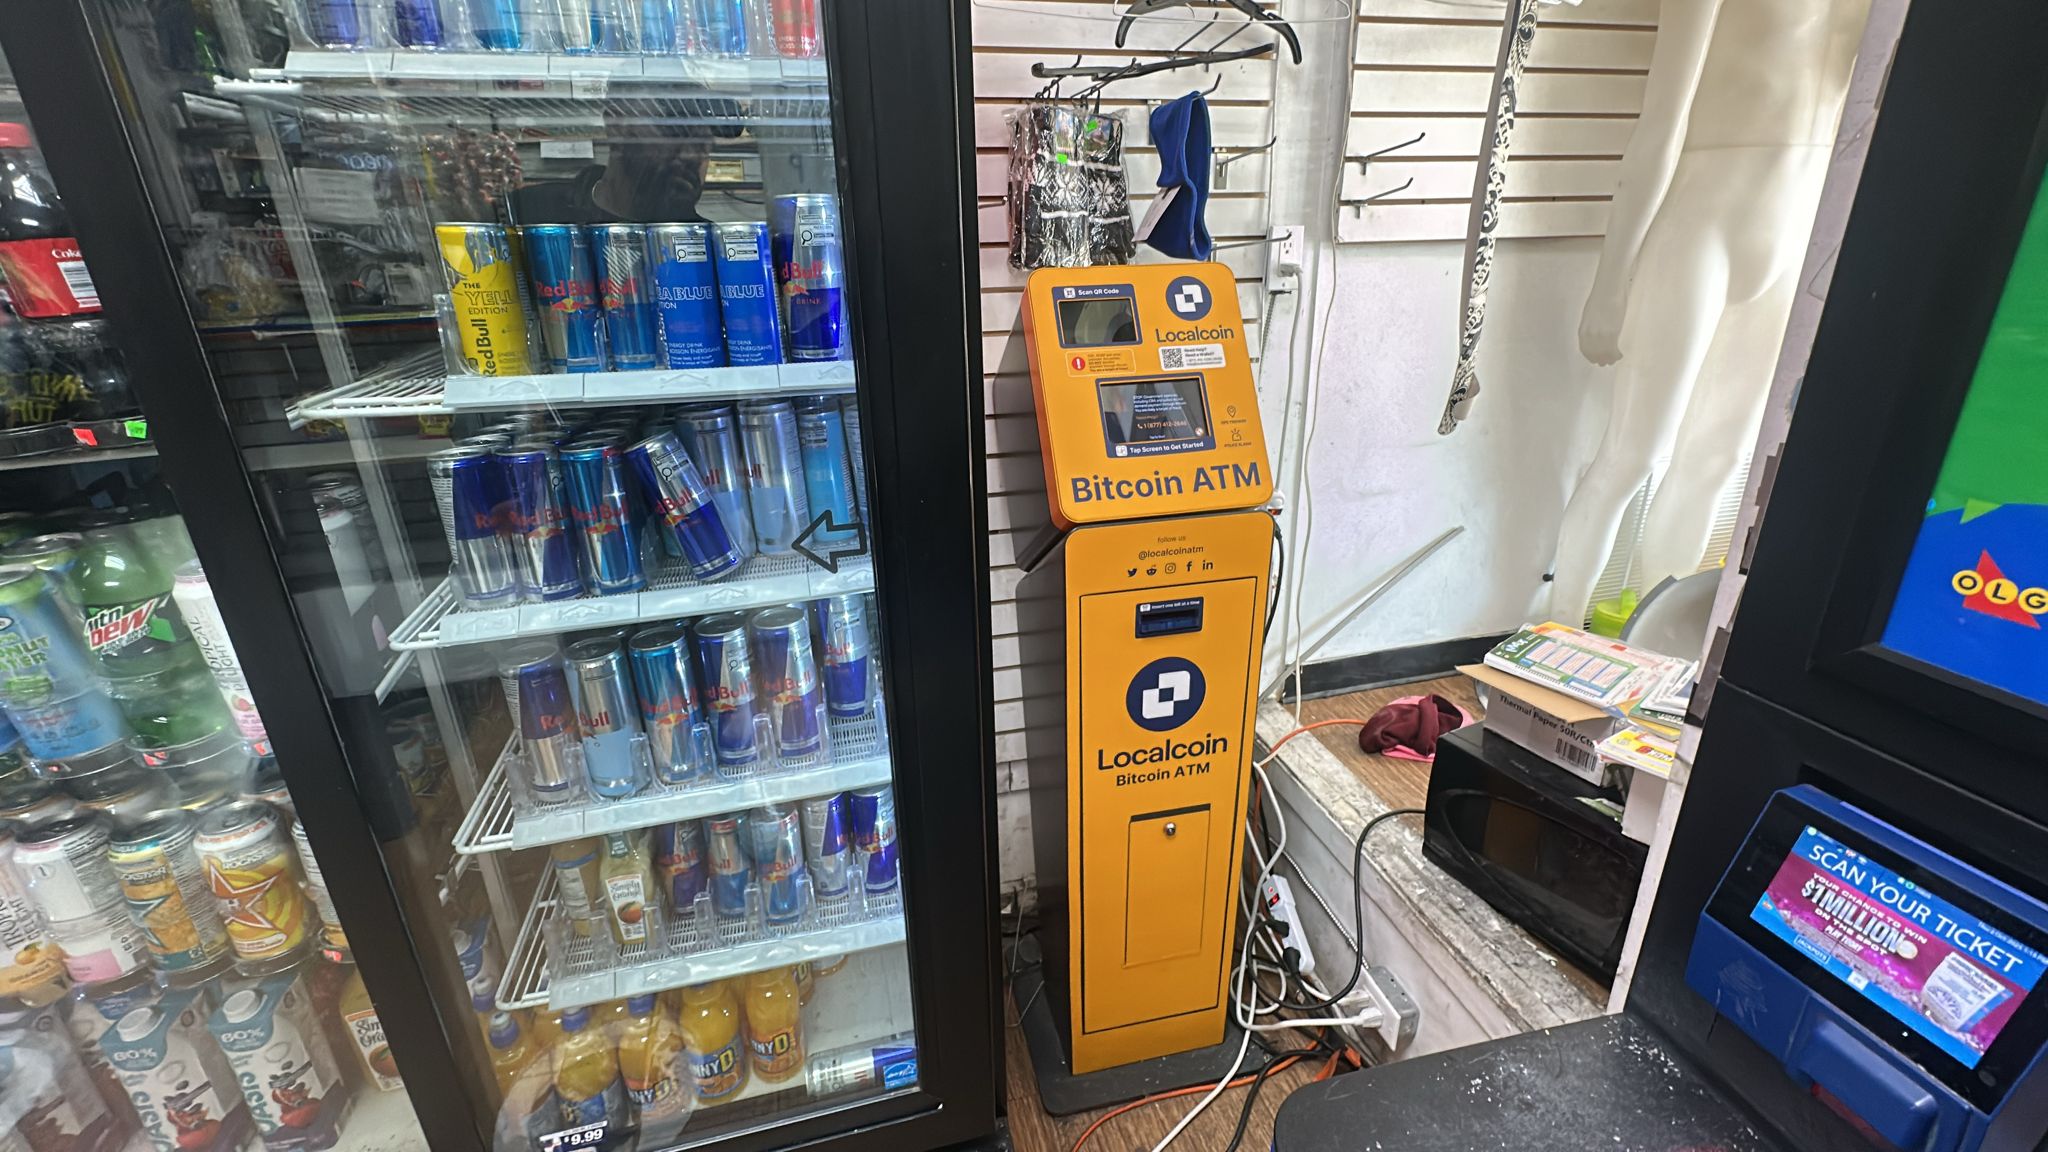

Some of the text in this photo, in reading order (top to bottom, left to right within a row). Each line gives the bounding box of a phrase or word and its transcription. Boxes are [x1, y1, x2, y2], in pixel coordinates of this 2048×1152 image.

[674, 286, 713, 300] BLUE
[727, 284, 764, 298] BLUE
[468, 306, 508, 315] EDITION
[471, 318, 491, 348] Bull
[1156, 325, 1234, 343] Localcoin
[1070, 462, 1261, 503] Bitcoin ATM
[1138, 546, 1204, 560] @localcoinatm
[1958, 575, 2046, 609] OLG
[720, 681, 749, 700] Bull
[1500, 695, 1532, 716] Thermal
[1534, 711, 1558, 728] Paper
[1098, 733, 1228, 771] Localcoin
[1116, 762, 1210, 786] Bitcoin ATM
[1809, 844, 2023, 972] SCAN YOUR TICKET
[1813, 872, 1928, 944] YOUR CHANCE TO WIN
[1814, 908, 1888, 956] ON THE SPOT
[1798, 938, 1828, 961] JACKPOTS
[564, 1128, 604, 1146] $9.99
